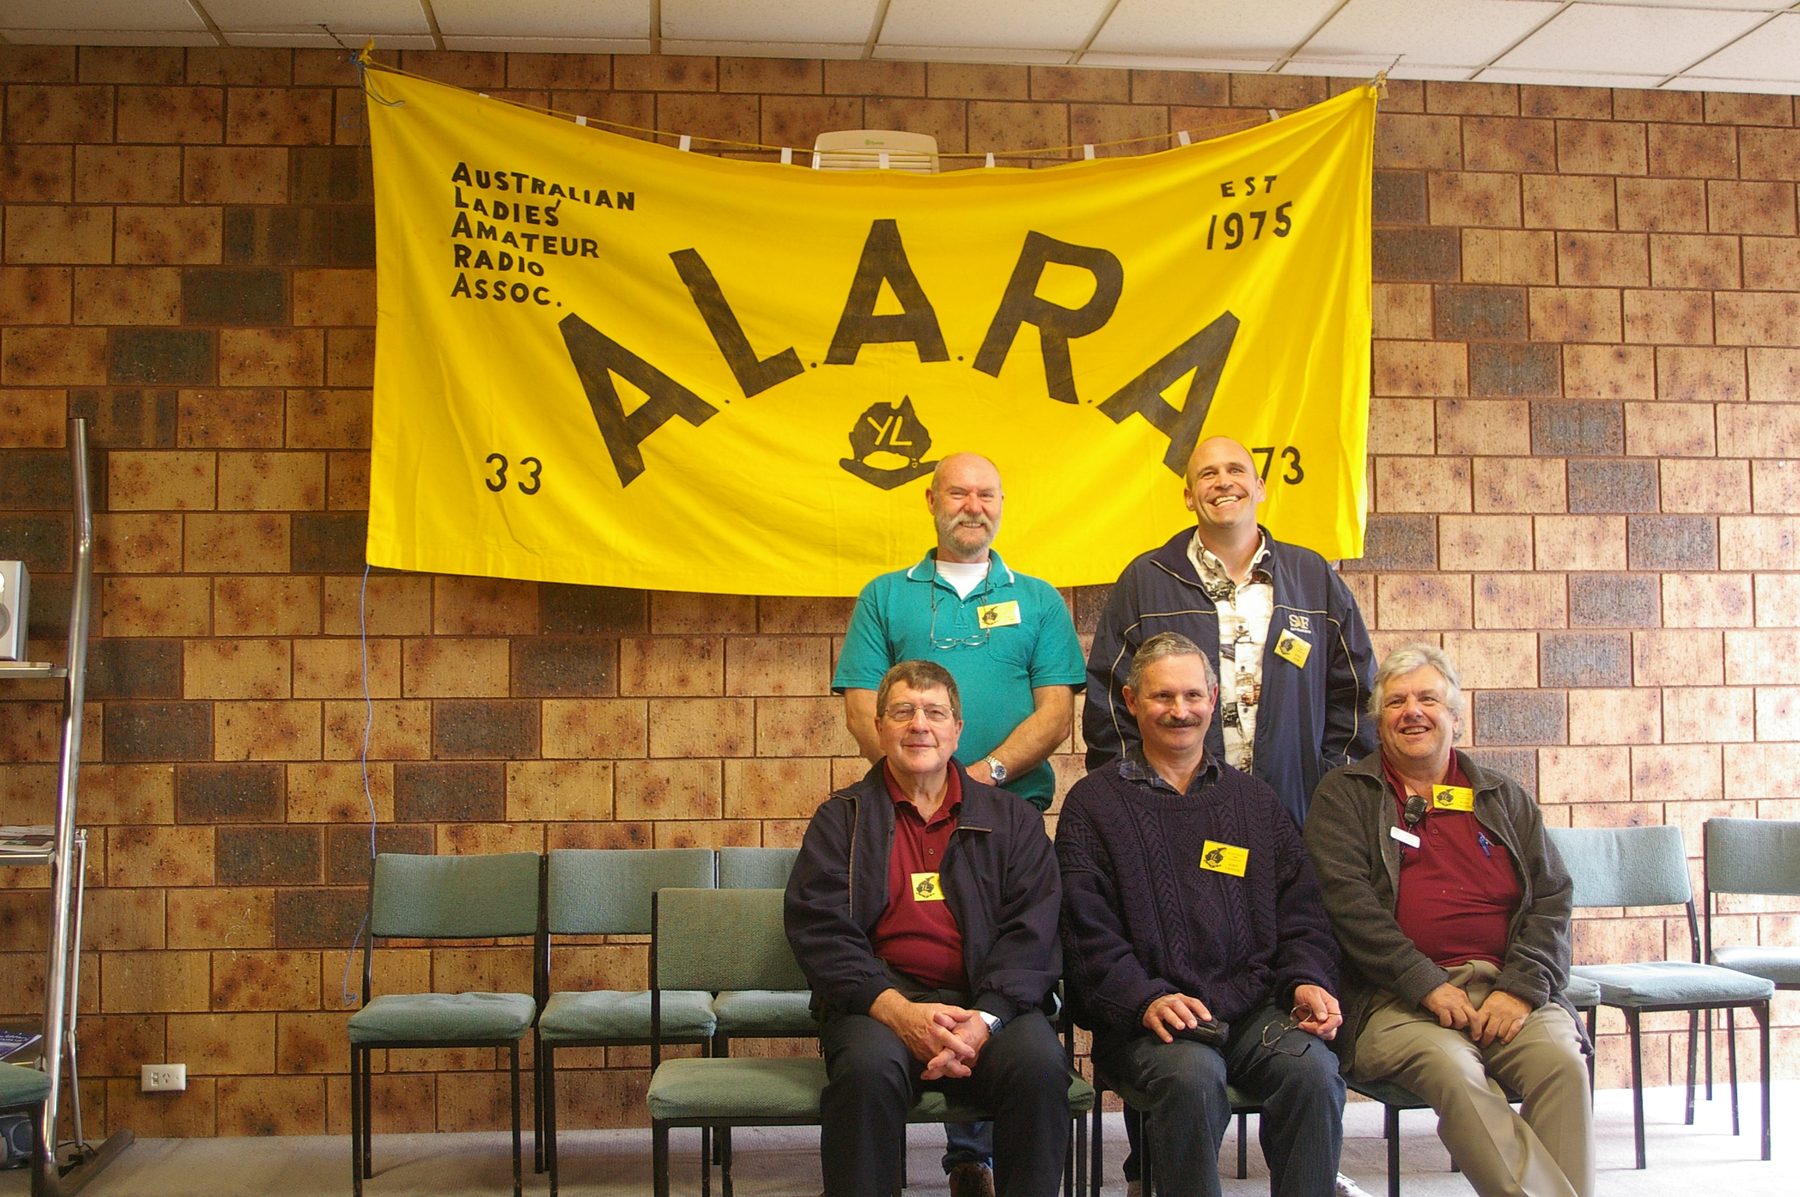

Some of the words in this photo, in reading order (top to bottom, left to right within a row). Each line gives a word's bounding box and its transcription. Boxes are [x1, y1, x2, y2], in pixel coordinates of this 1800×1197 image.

[451, 162, 635, 211] AUSTRALIAN
[1221, 175, 1277, 197] EST
[451, 212, 600, 258] AMATEUR
[1206, 201, 1294, 250] 1975
[454, 244, 544, 277] RADIO
[451, 272, 562, 307] ASSOC.
[867, 416, 912, 446] YL
[485, 453, 543, 495] 33
[1252, 446, 1305, 485] 73
